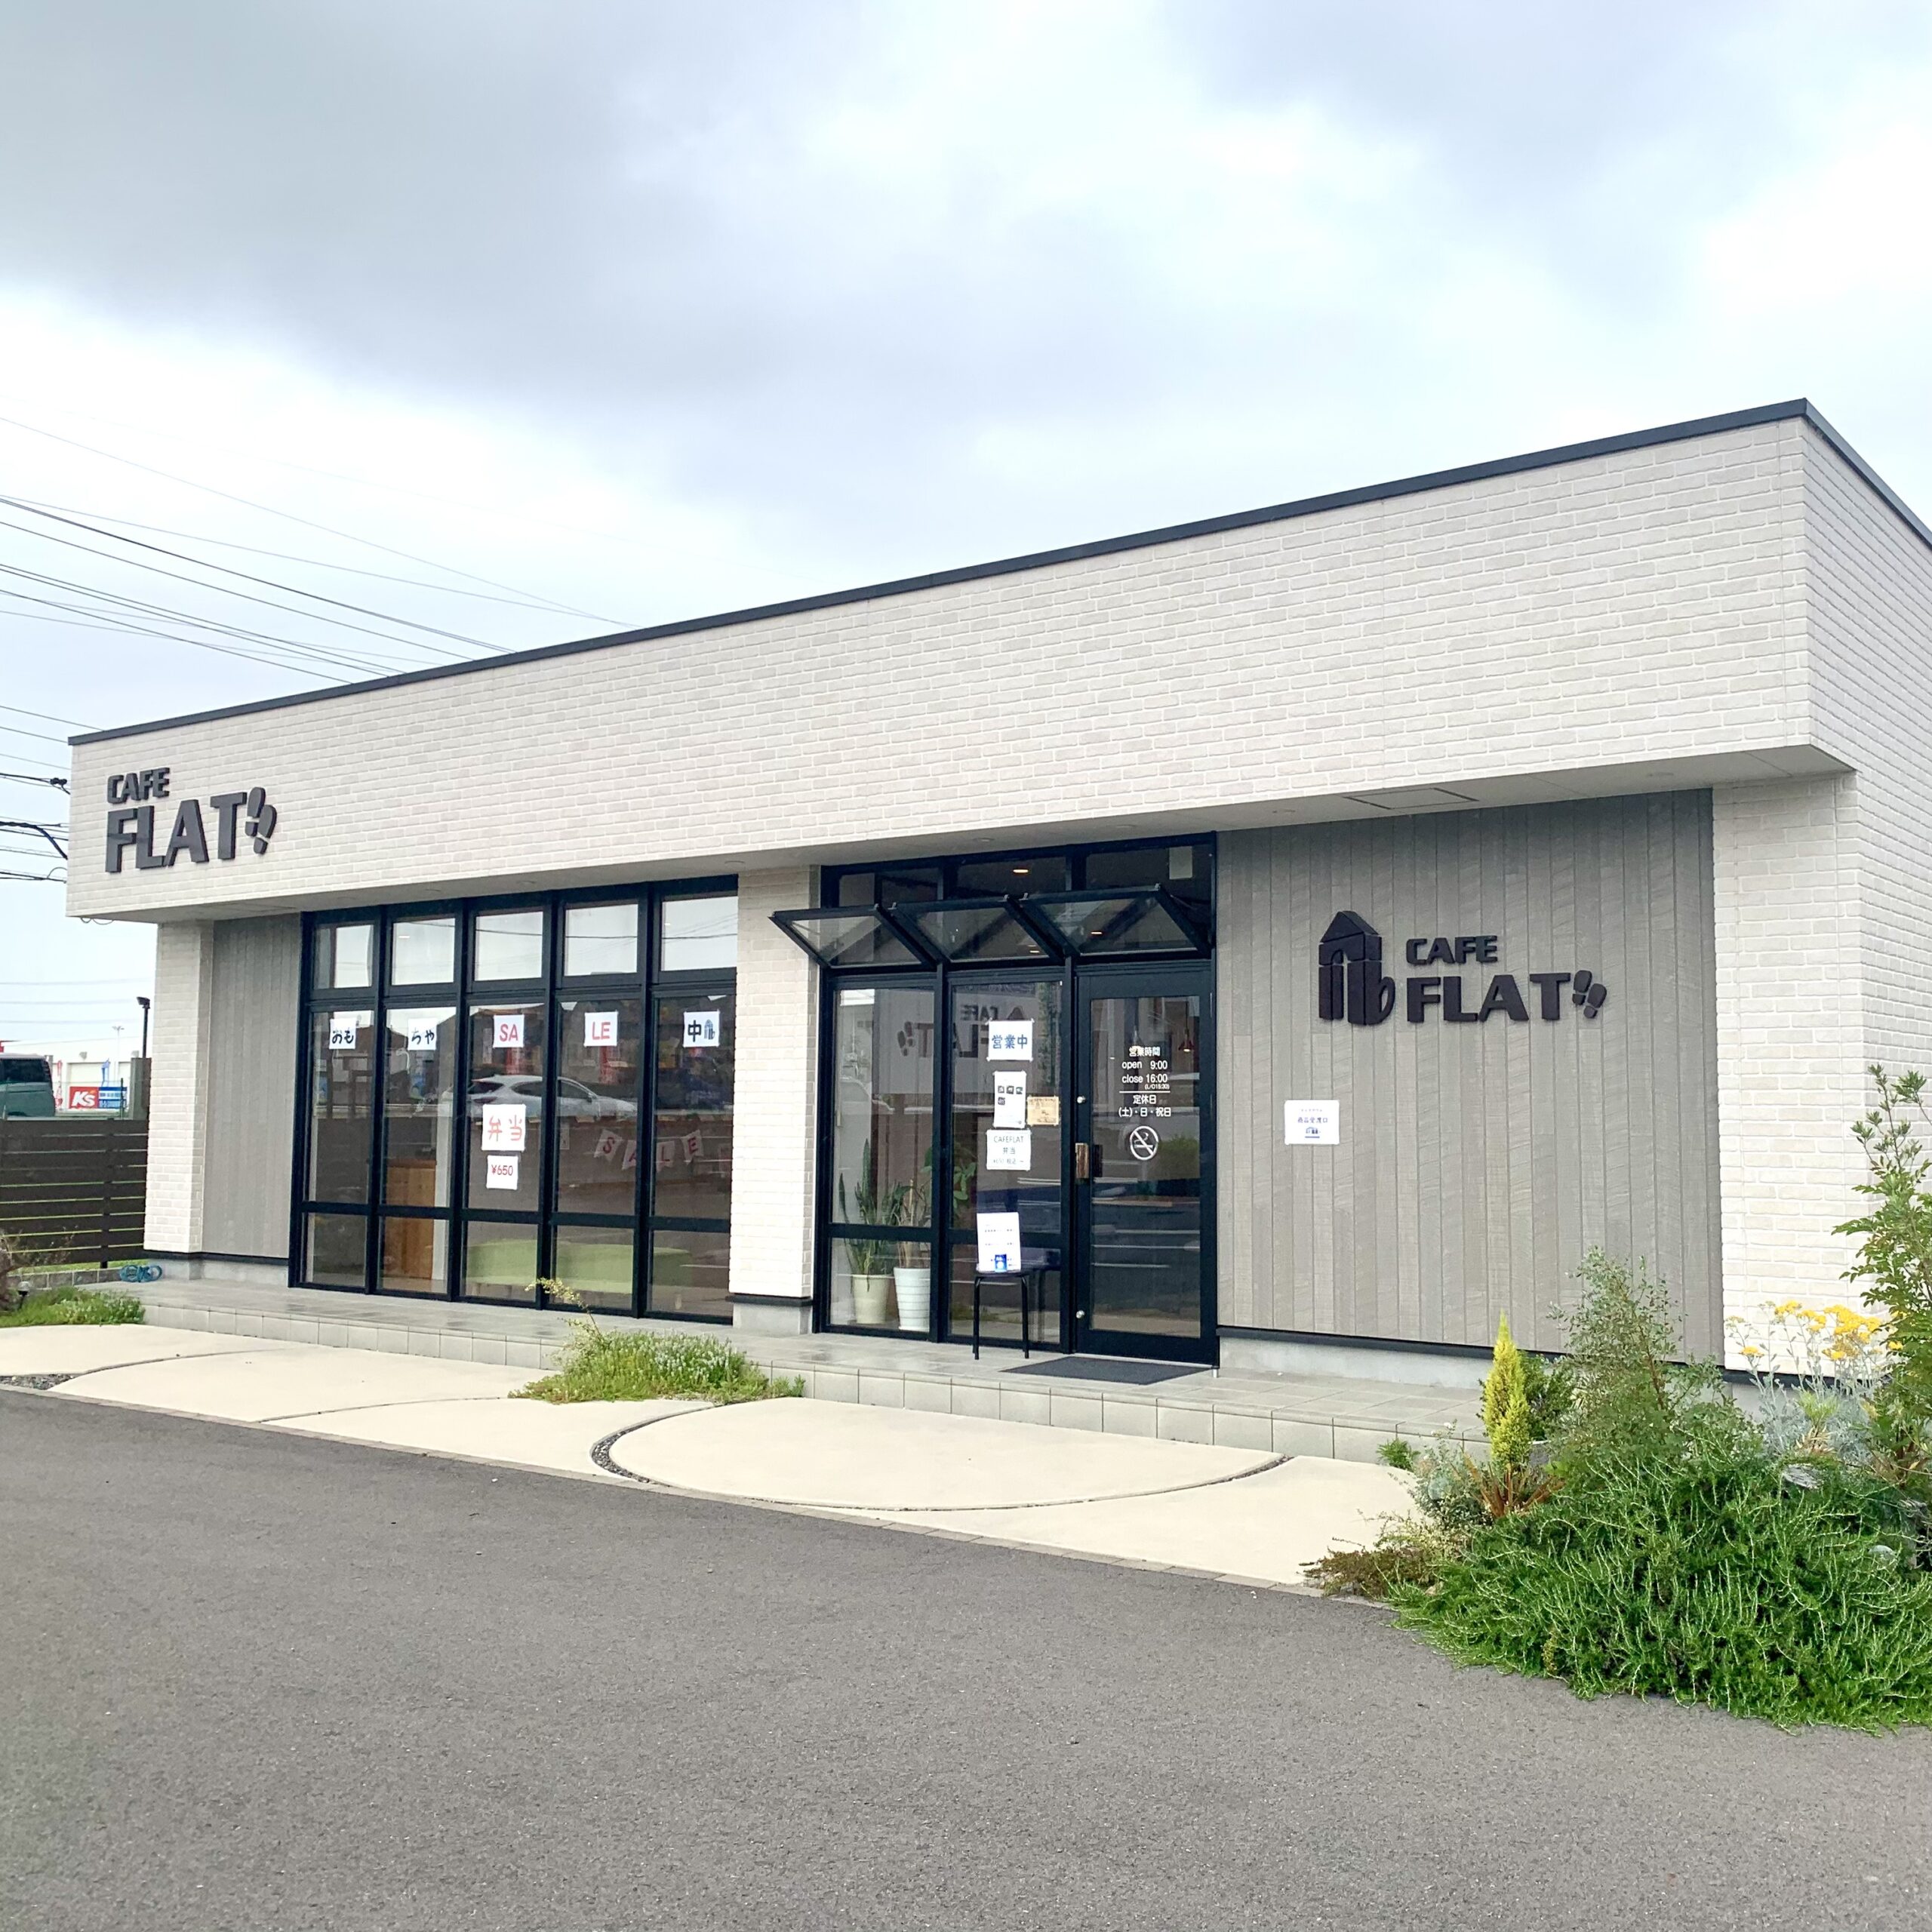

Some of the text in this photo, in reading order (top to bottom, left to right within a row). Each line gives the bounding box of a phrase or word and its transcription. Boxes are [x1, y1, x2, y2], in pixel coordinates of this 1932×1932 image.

[107, 767, 170, 804] CAFE
[105, 792, 248, 873] FLAT
[1406, 935, 1498, 964] CAFE
[1406, 971, 1571, 1023] FLAT
[332, 1027, 354, 1044] おも
[499, 1023, 518, 1042] SA
[592, 1022, 611, 1040] LE
[991, 1033, 1029, 1050] 営業中
[1129, 1046, 1161, 1057] 営業時間
[1121, 1060, 1168, 1070] open 9:00
[1121, 1073, 1168, 1083] close 16:00
[1133, 1094, 1157, 1104] 定休日
[488, 1115, 523, 1142] 弁当
[491, 1164, 514, 1176] ¥650
